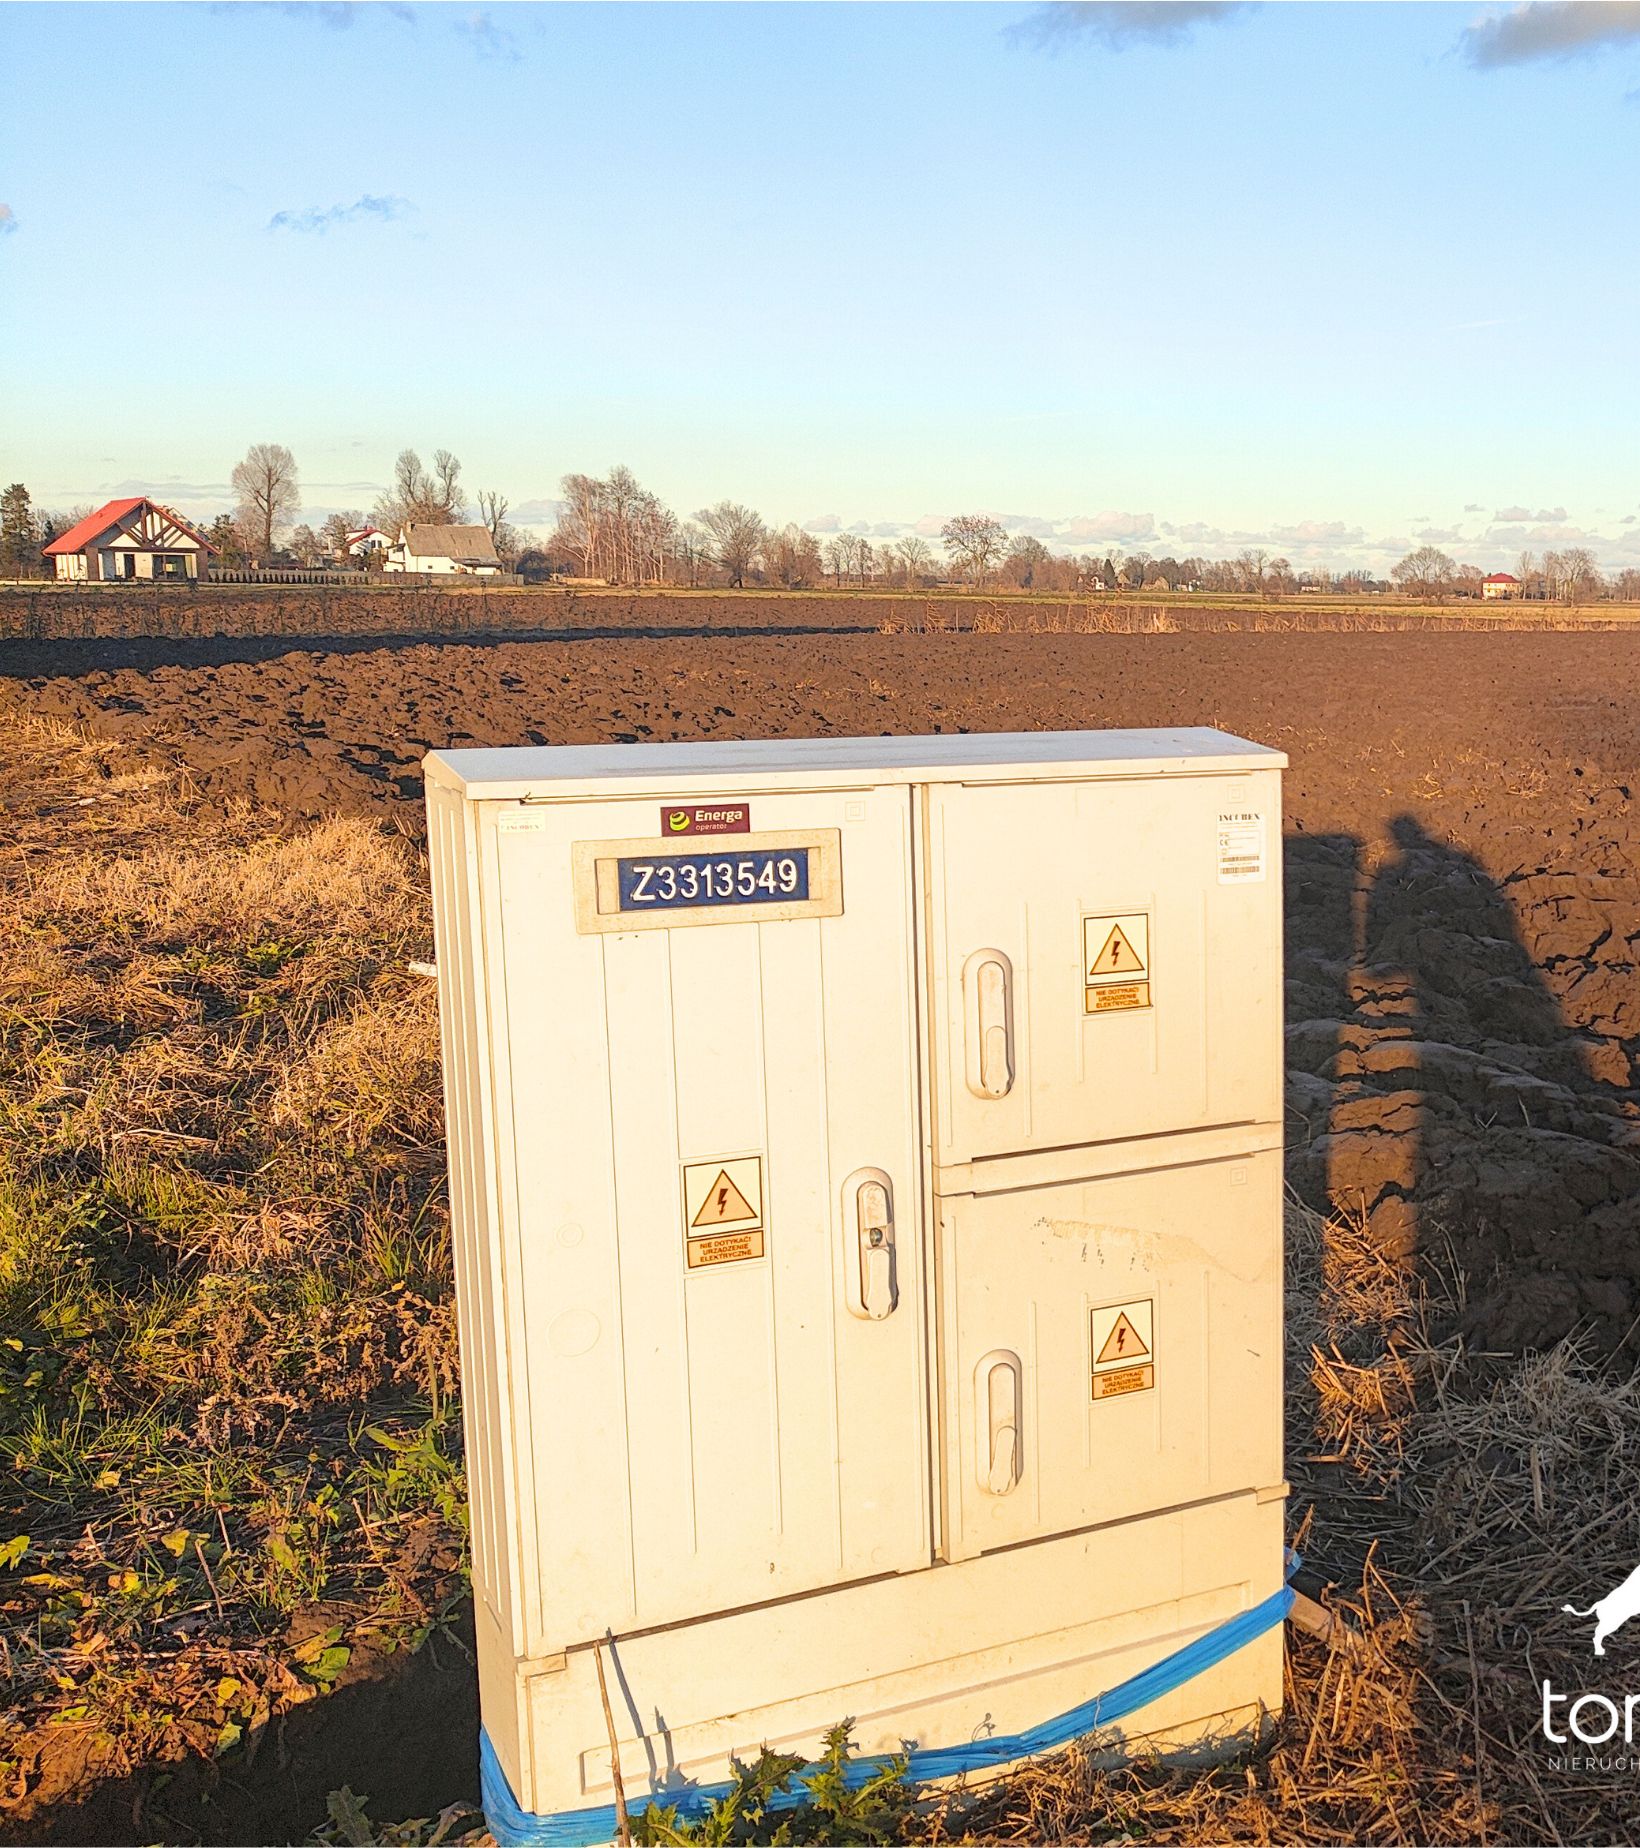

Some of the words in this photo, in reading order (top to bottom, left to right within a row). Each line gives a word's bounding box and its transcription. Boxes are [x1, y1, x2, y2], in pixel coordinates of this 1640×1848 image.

[695, 810, 743, 823] Energa
[695, 823, 727, 831] operator
[632, 858, 798, 902] Z3313549
[700, 1249, 752, 1262] ELEKTRYCZNE
